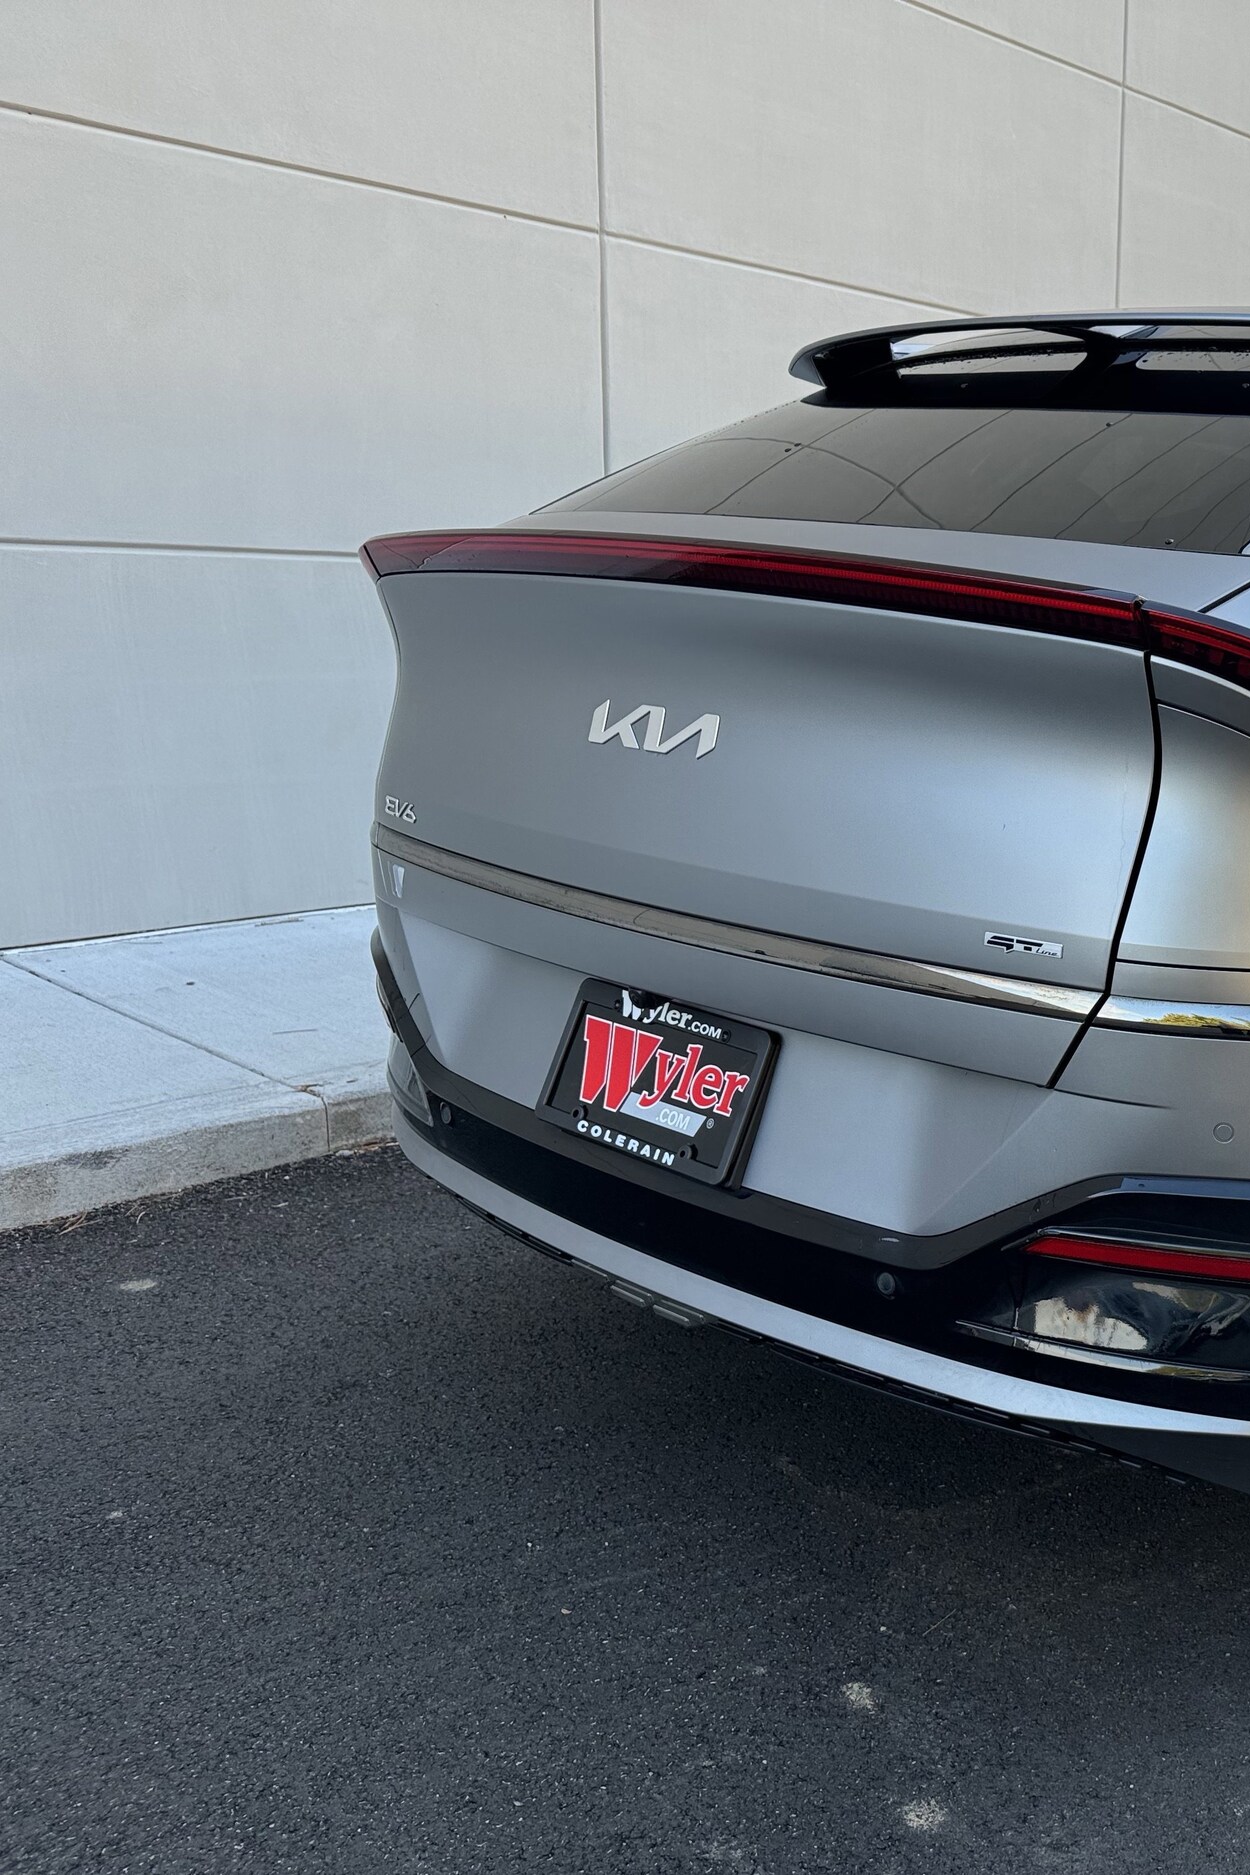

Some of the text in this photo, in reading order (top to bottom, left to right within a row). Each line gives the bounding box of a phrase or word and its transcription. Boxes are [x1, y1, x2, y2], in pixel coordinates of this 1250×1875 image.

[588, 699, 719, 760] KIA
[385, 795, 416, 823] EV6
[579, 1014, 750, 1117] Wyler
[577, 1119, 675, 1166] COLERAIN
[655, 1108, 690, 1130] .COM
